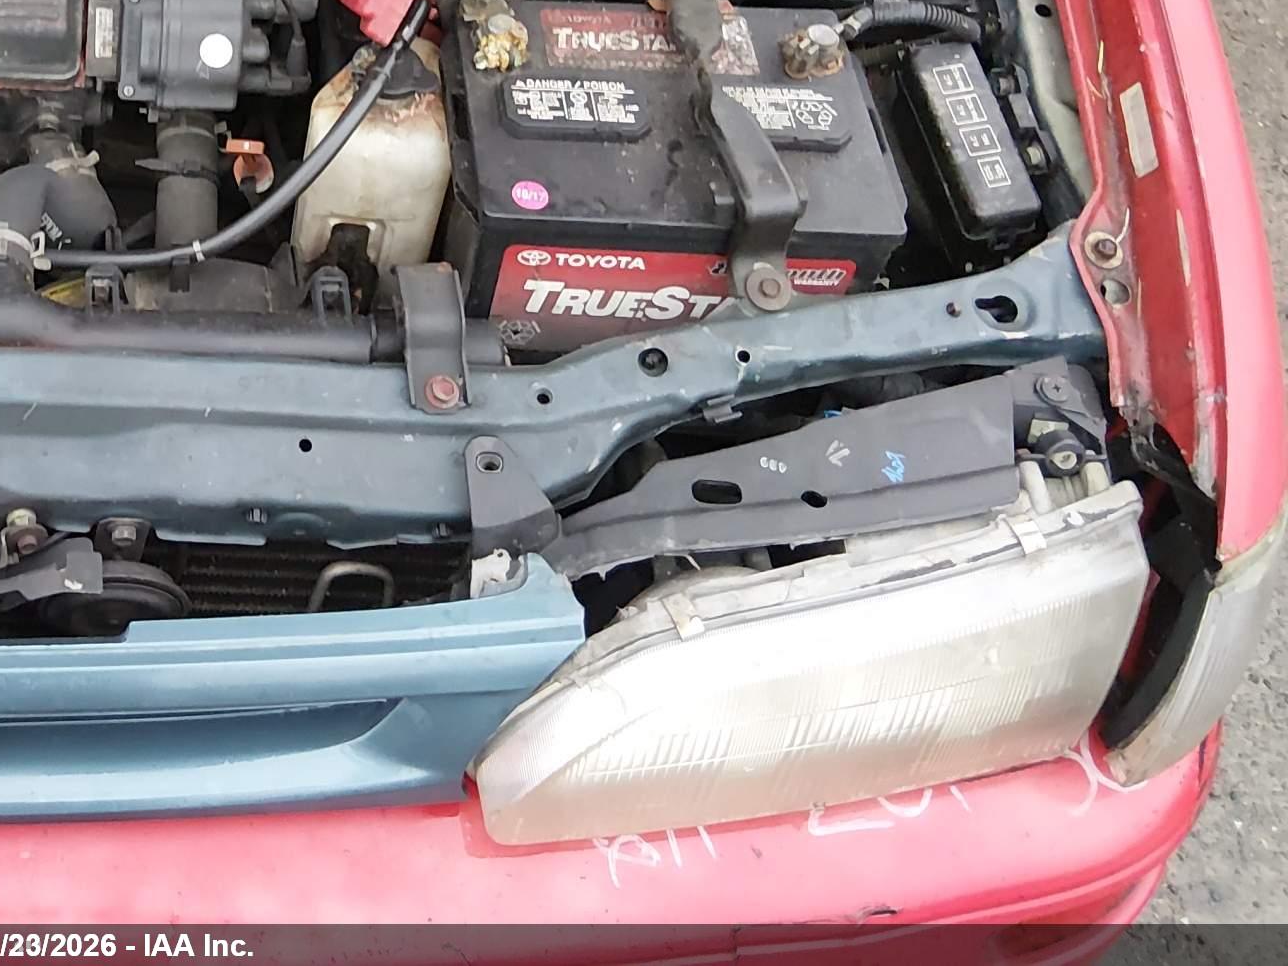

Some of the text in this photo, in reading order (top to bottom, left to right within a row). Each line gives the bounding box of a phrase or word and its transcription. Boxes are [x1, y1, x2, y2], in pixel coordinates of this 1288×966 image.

[526, 79, 572, 89] DANGER
[583, 80, 625, 91] POISON
[555, 253, 646, 271] TOYOTA
